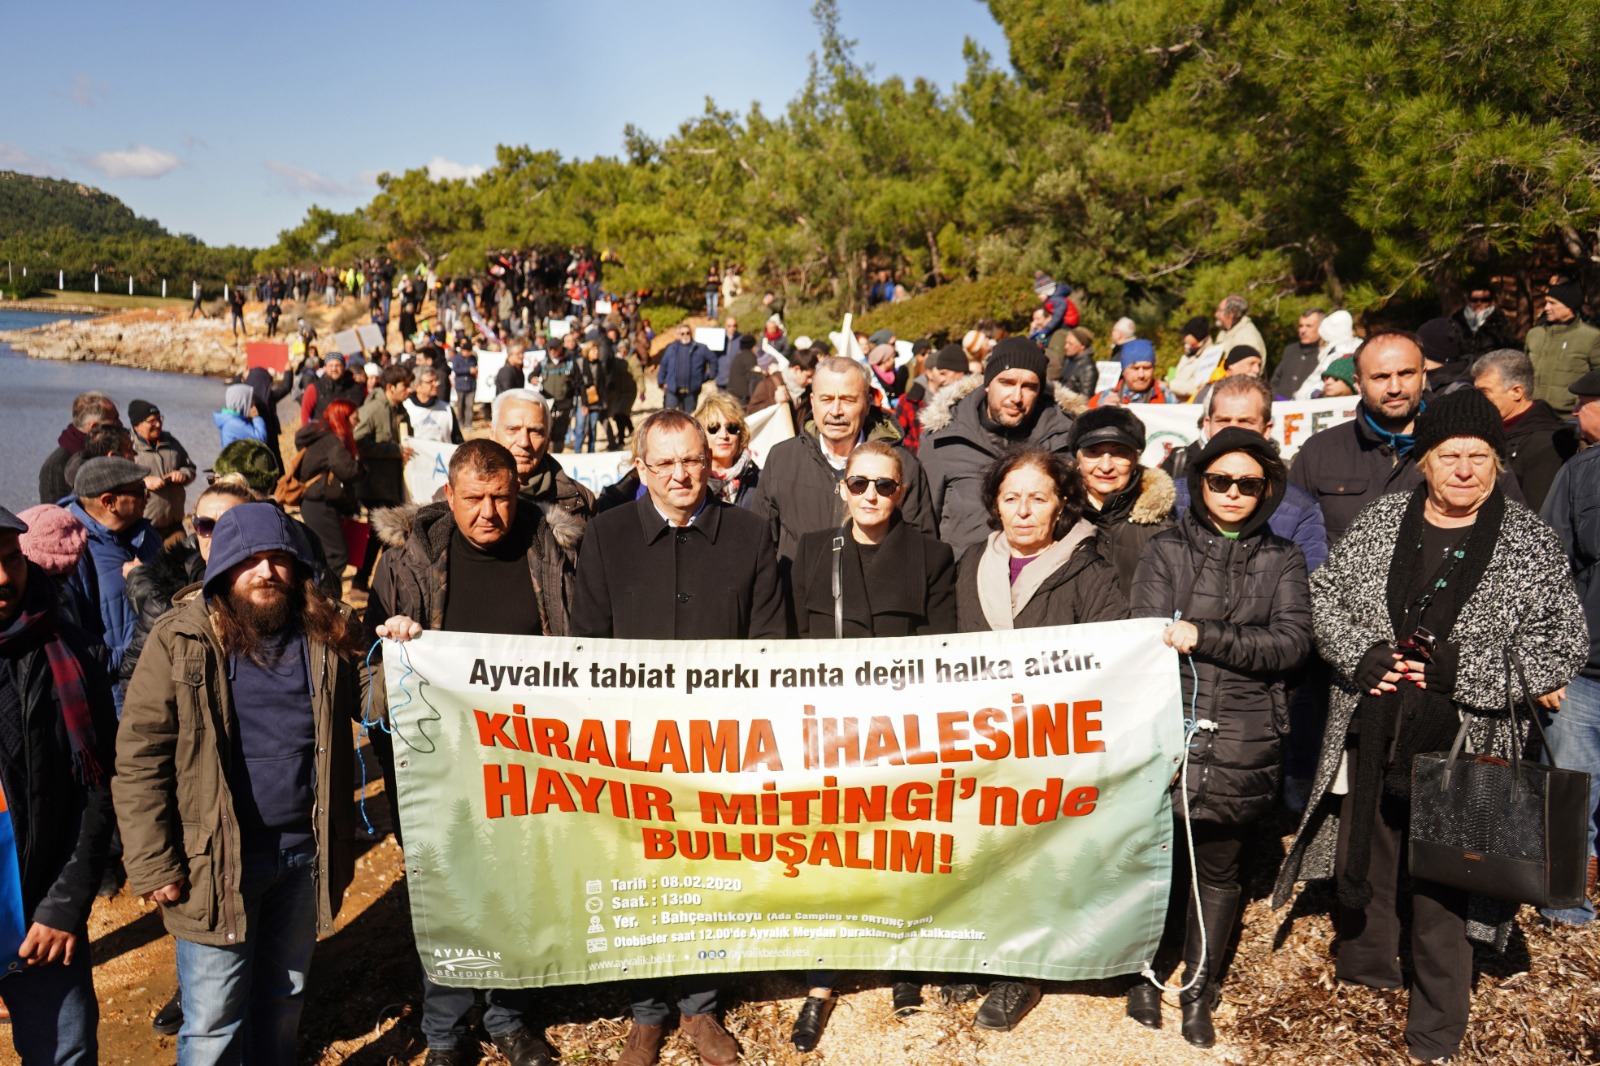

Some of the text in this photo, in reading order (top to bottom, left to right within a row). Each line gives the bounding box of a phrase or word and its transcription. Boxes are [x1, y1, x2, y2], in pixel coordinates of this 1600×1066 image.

[469, 649, 1101, 694] Ayvalık tabiat parkı ranta değil halka aittir.
[473, 693, 1106, 773] KİRALAMA İHALESİNE
[483, 764, 676, 820] HAYIR
[642, 828, 954, 877] BULUŞALIM!
[611, 879, 647, 892] Tarih
[660, 876, 742, 892] 08.02.2020
[611, 896, 650, 910] Saat.
[661, 893, 702, 906] 13:00
[612, 915, 639, 929] Yer.
[661, 911, 762, 926] Bahçealtıkoyu
[794, 912, 842, 922] Camping
[861, 914, 905, 928] ORTUNÇ
[614, 932, 668, 948] Otobüsler
[671, 931, 696, 942] saat
[749, 926, 791, 941] Ayvalık
[793, 926, 837, 940] Meydan
[839, 928, 918, 941] Duraklarından
[920, 926, 987, 941] kalkacaktır.
[434, 949, 501, 959] AYVALIK
